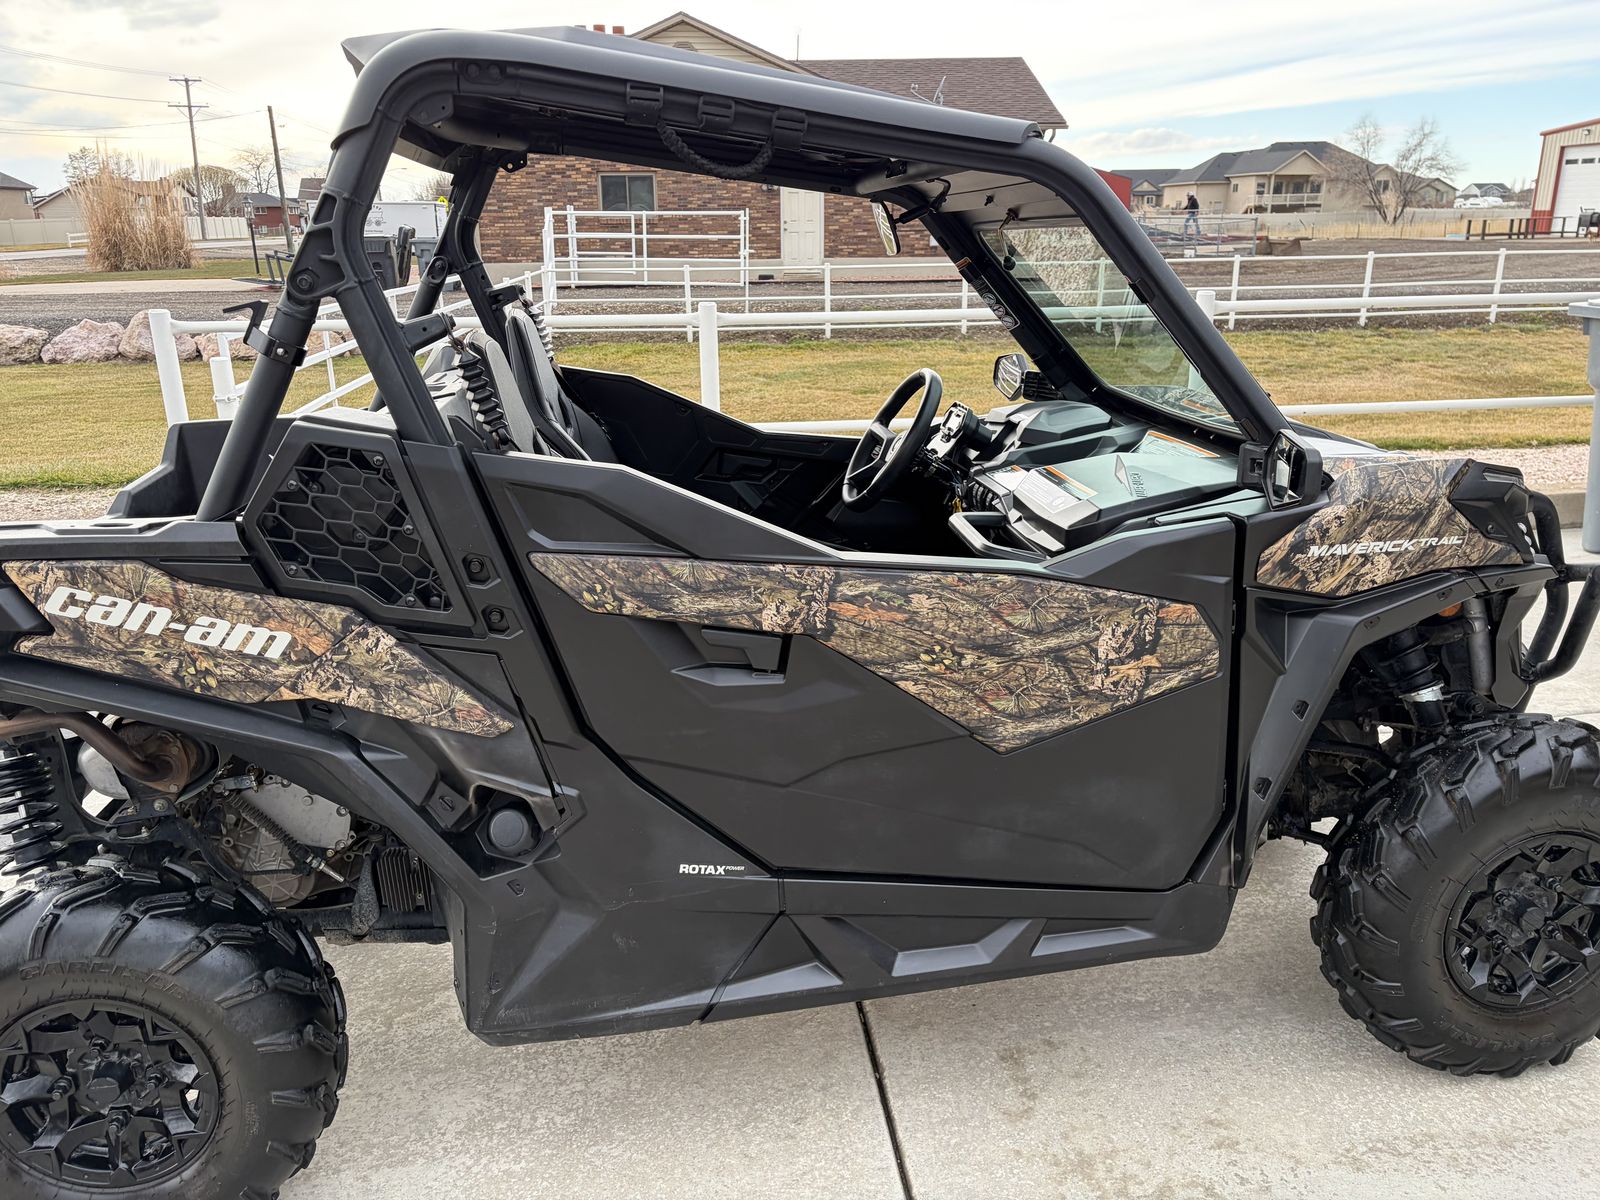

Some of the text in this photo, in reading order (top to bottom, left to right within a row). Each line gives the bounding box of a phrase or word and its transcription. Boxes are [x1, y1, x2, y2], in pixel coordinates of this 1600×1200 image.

[1307, 535, 1464, 557] MAVERICK TRAIL
[44, 586, 292, 659] can-am
[679, 863, 726, 875] ROTAX
